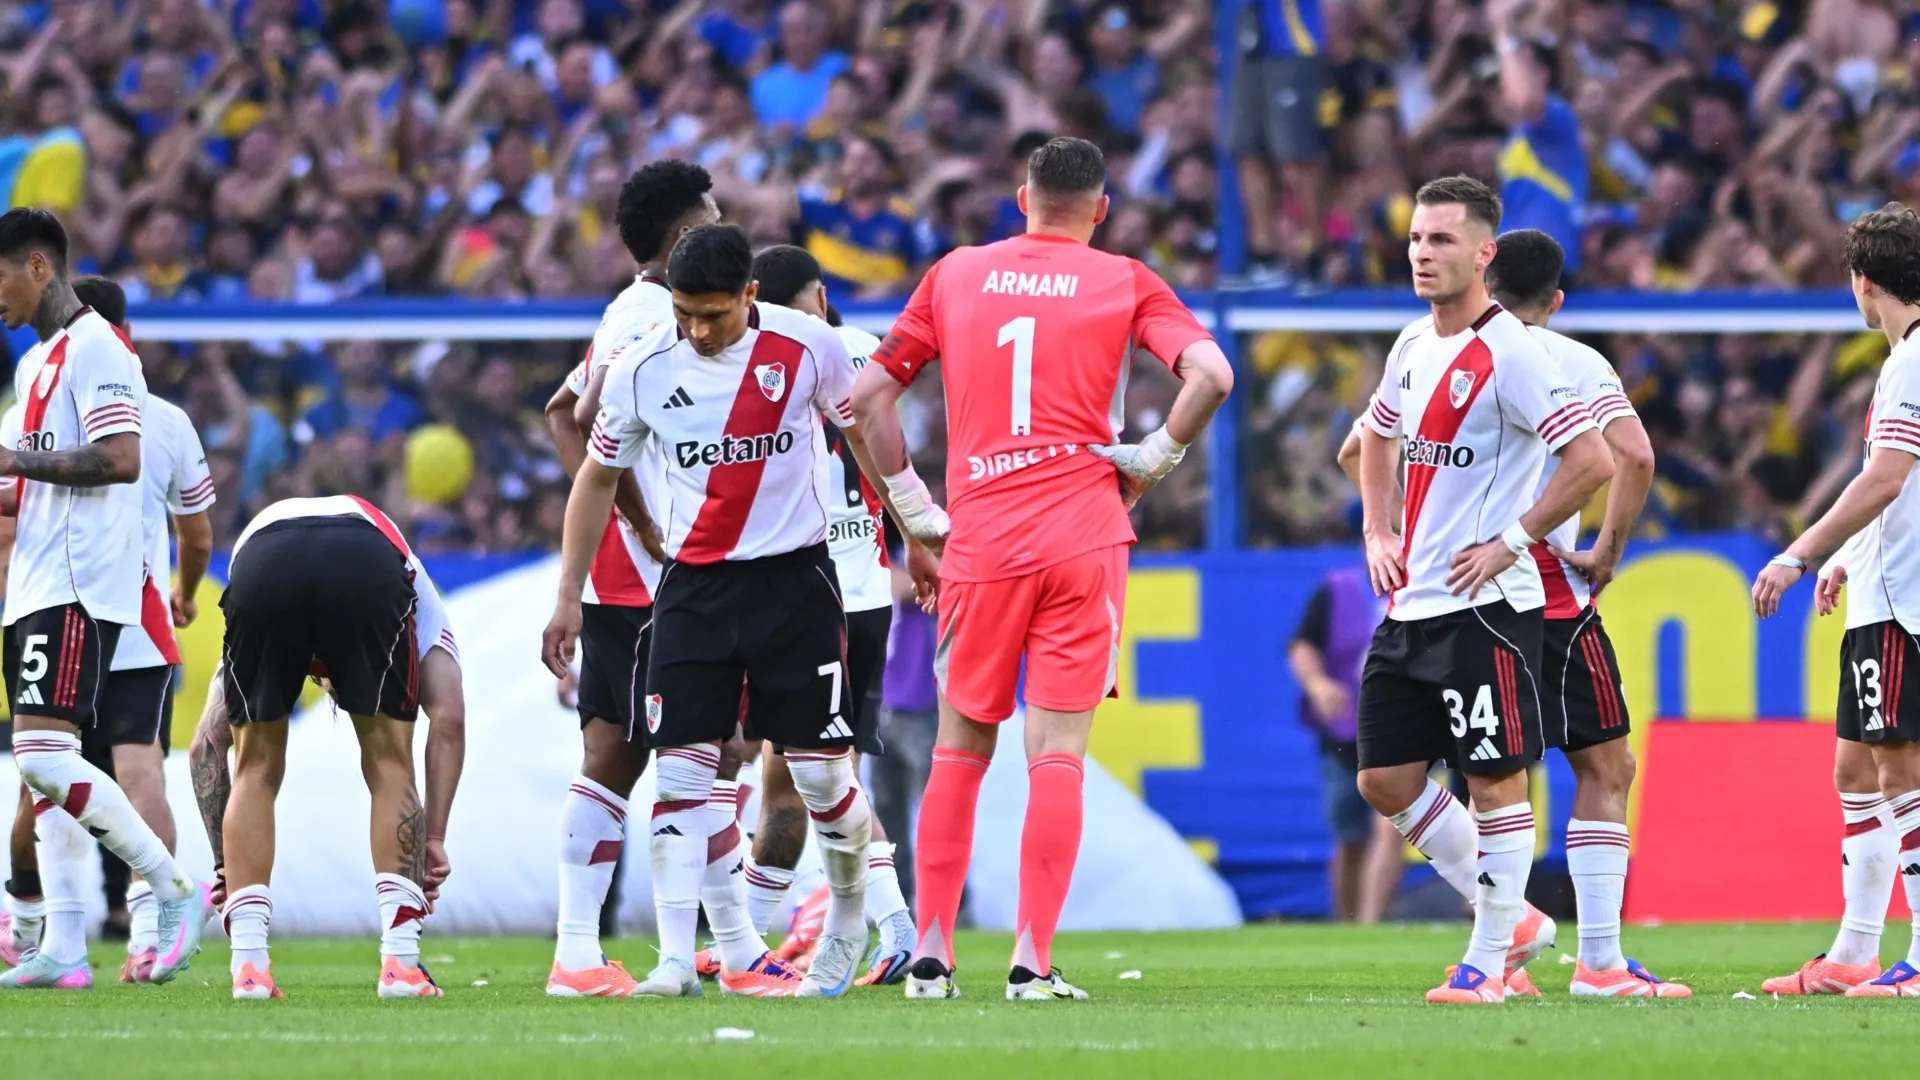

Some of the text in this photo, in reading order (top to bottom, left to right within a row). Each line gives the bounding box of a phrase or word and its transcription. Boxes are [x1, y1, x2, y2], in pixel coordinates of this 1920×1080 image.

[981, 269, 1079, 298] ARMANI
[997, 316, 1036, 436] 1
[676, 431, 794, 468] Betano
[1403, 434, 1475, 468] etano
[828, 519, 876, 542] DIRE
[21, 635, 48, 681] 5
[818, 661, 842, 714] 7
[1443, 684, 1499, 738] 34
